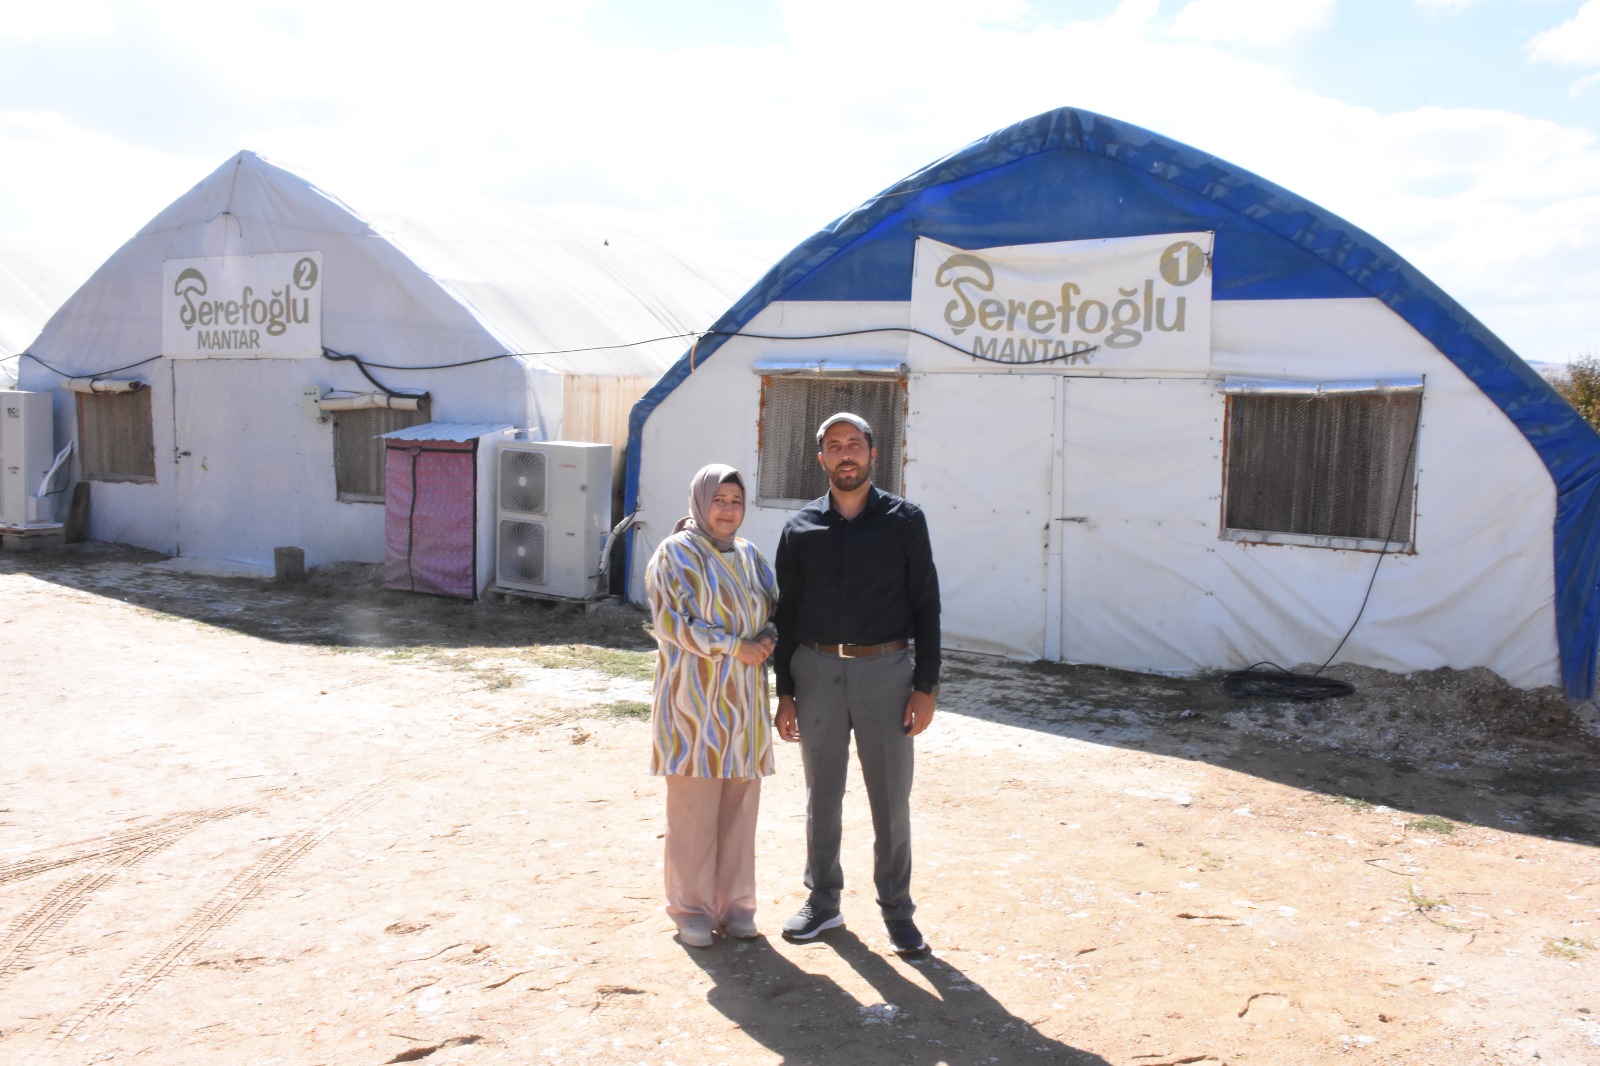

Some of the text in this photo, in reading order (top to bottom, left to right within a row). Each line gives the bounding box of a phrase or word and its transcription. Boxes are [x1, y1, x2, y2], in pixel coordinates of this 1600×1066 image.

[298, 259, 313, 288] 2
[174, 268, 309, 337] Şerefoğlu
[935, 254, 1186, 349] Şerefoğlu
[197, 329, 260, 350] MANTAR
[971, 335, 1091, 366] MANTAR
